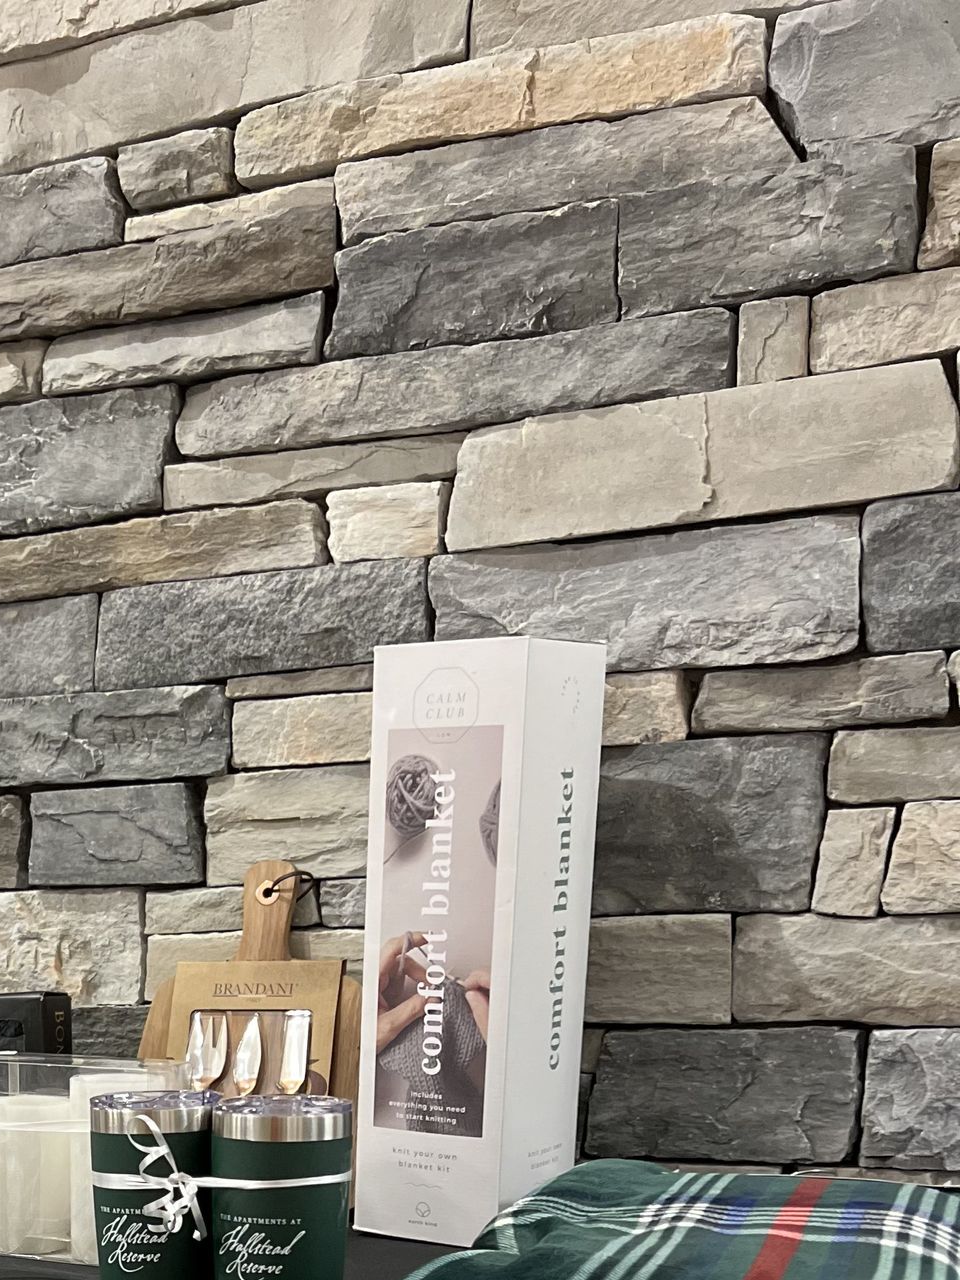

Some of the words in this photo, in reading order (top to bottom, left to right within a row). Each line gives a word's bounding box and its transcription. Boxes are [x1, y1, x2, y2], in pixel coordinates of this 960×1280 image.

[426, 692, 467, 704] CALM
[425, 707, 465, 720] CLUB
[421, 768, 457, 916] blanket
[553, 767, 575, 913] blanket
[213, 983, 295, 995] BRANDANI
[417, 929, 449, 1076] comfort
[548, 925, 567, 1071] comfort
[388, 1100, 428, 1111] everything
[445, 1106, 466, 1114] need
[406, 1113, 423, 1121] start
[425, 1114, 457, 1125] knitting
[392, 1147, 411, 1156] knit
[413, 1150, 434, 1160] your
[438, 1153, 458, 1161] own
[398, 1160, 433, 1171] blanket
[437, 1164, 451, 1173] kit
[100, 1205, 111, 1213] THE
[220, 1213, 232, 1221] THE
[233, 1215, 287, 1225] APARTMENTS
[290, 1217, 302, 1225] AT
[101, 1214, 169, 1246] Hallstead
[218, 1223, 306, 1256] Hallstead
[107, 1240, 162, 1273] Reserve
